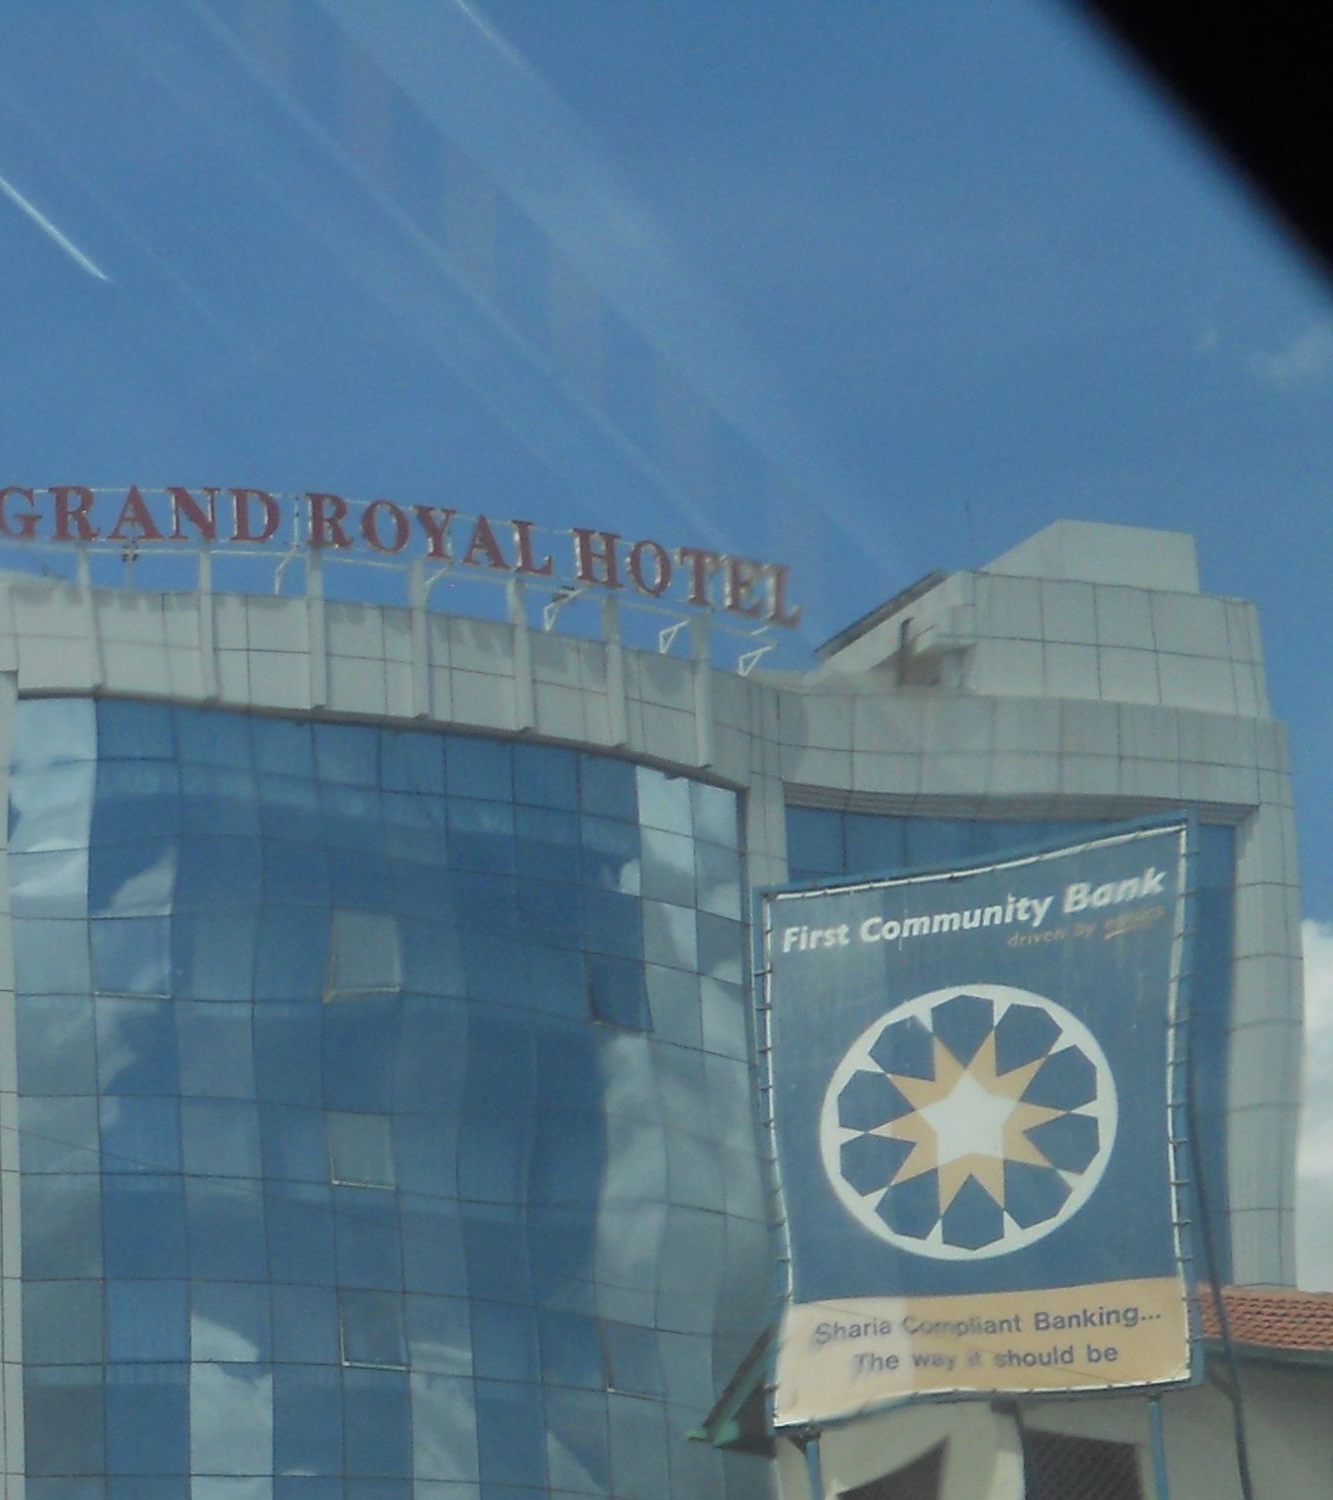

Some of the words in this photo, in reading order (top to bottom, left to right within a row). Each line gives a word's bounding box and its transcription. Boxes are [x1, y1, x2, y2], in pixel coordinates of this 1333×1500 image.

[305, 493, 554, 577] ROYAL
[571, 527, 803, 628] HOTEL
[782, 922, 850, 954] First
[860, 893, 1054, 943] Community
[1062, 867, 1166, 914] Bank
[1007, 928, 1066, 948] driven
[1074, 922, 1096, 939] by
[812, 1316, 892, 1347] Sharia
[902, 1314, 1023, 1338] Compliant
[1034, 1305, 1162, 1332] Banking...
[852, 1351, 900, 1374] The
[912, 1353, 958, 1372] way
[968, 1350, 982, 1367] it
[995, 1345, 1074, 1369] should
[1087, 1344, 1119, 1364] be
